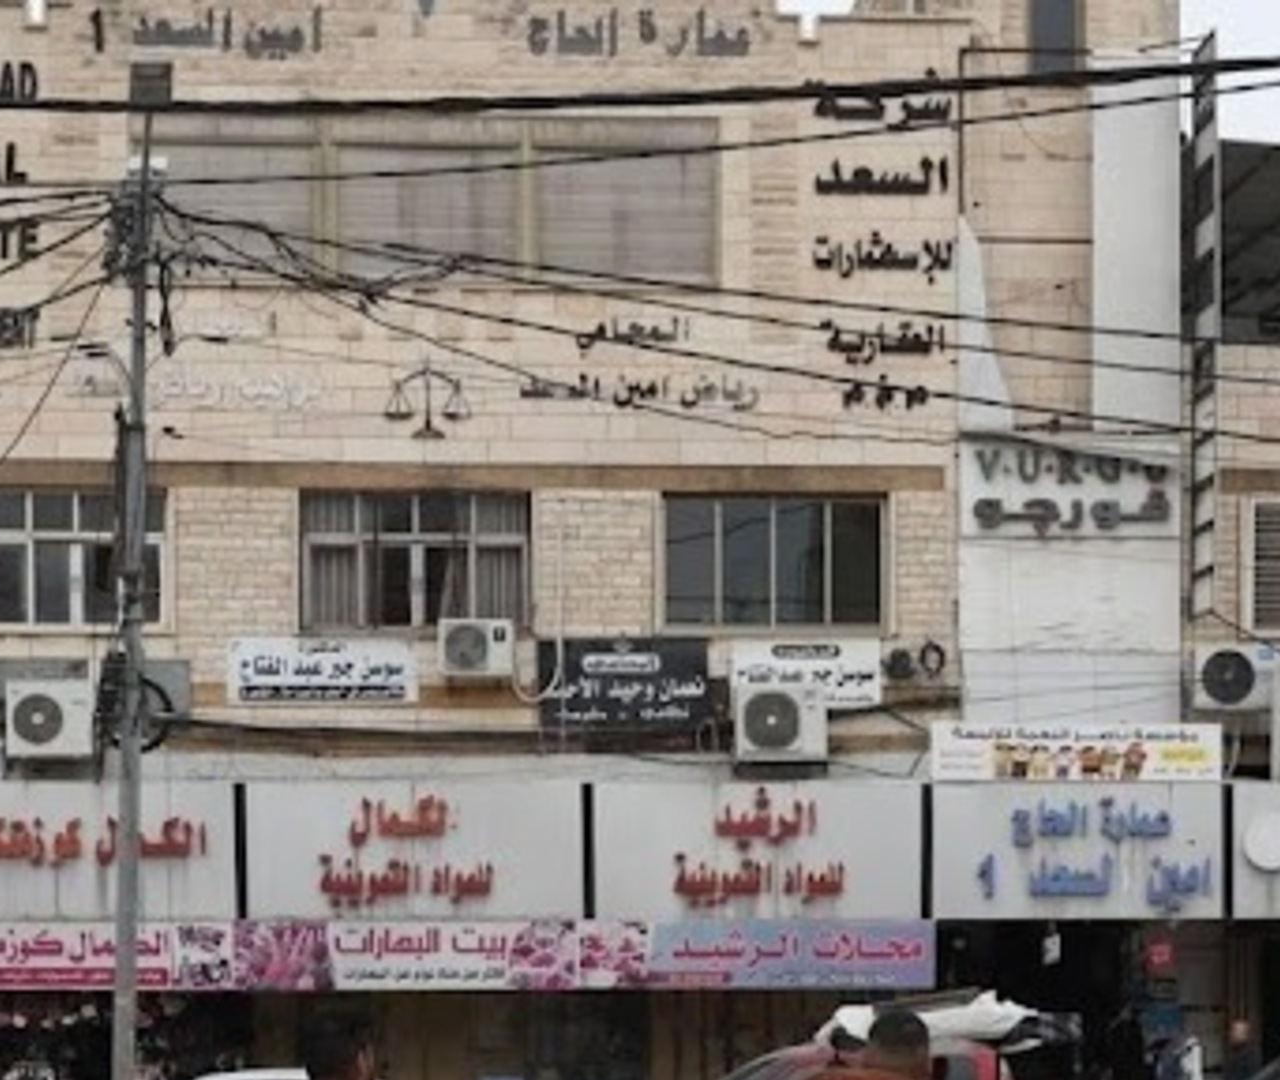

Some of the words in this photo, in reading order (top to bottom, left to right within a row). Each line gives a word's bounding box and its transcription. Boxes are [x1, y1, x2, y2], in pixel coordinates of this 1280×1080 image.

[134, 8, 231, 51] السعد
[528, 7, 617, 56] الحاج
[638, 7, 749, 56] عمارة
[814, 156, 949, 195] السعد
[821, 319, 945, 364] العقارية
[96, 814, 207, 868] الكمل
[714, 785, 816, 852] الرشيد
[1011, 797, 1088, 848] الحاج
[1098, 797, 1172, 844] عمارة
[318, 853, 422, 910] التموينية
[431, 860, 494, 906] للمواد
[672, 851, 773, 909] التموينية
[784, 860, 845, 906] للمواد
[334, 927, 441, 961] البهارات
[451, 928, 508, 961] بيت
[673, 929, 799, 967] الرشيد
[813, 931, 922, 961] محلات
